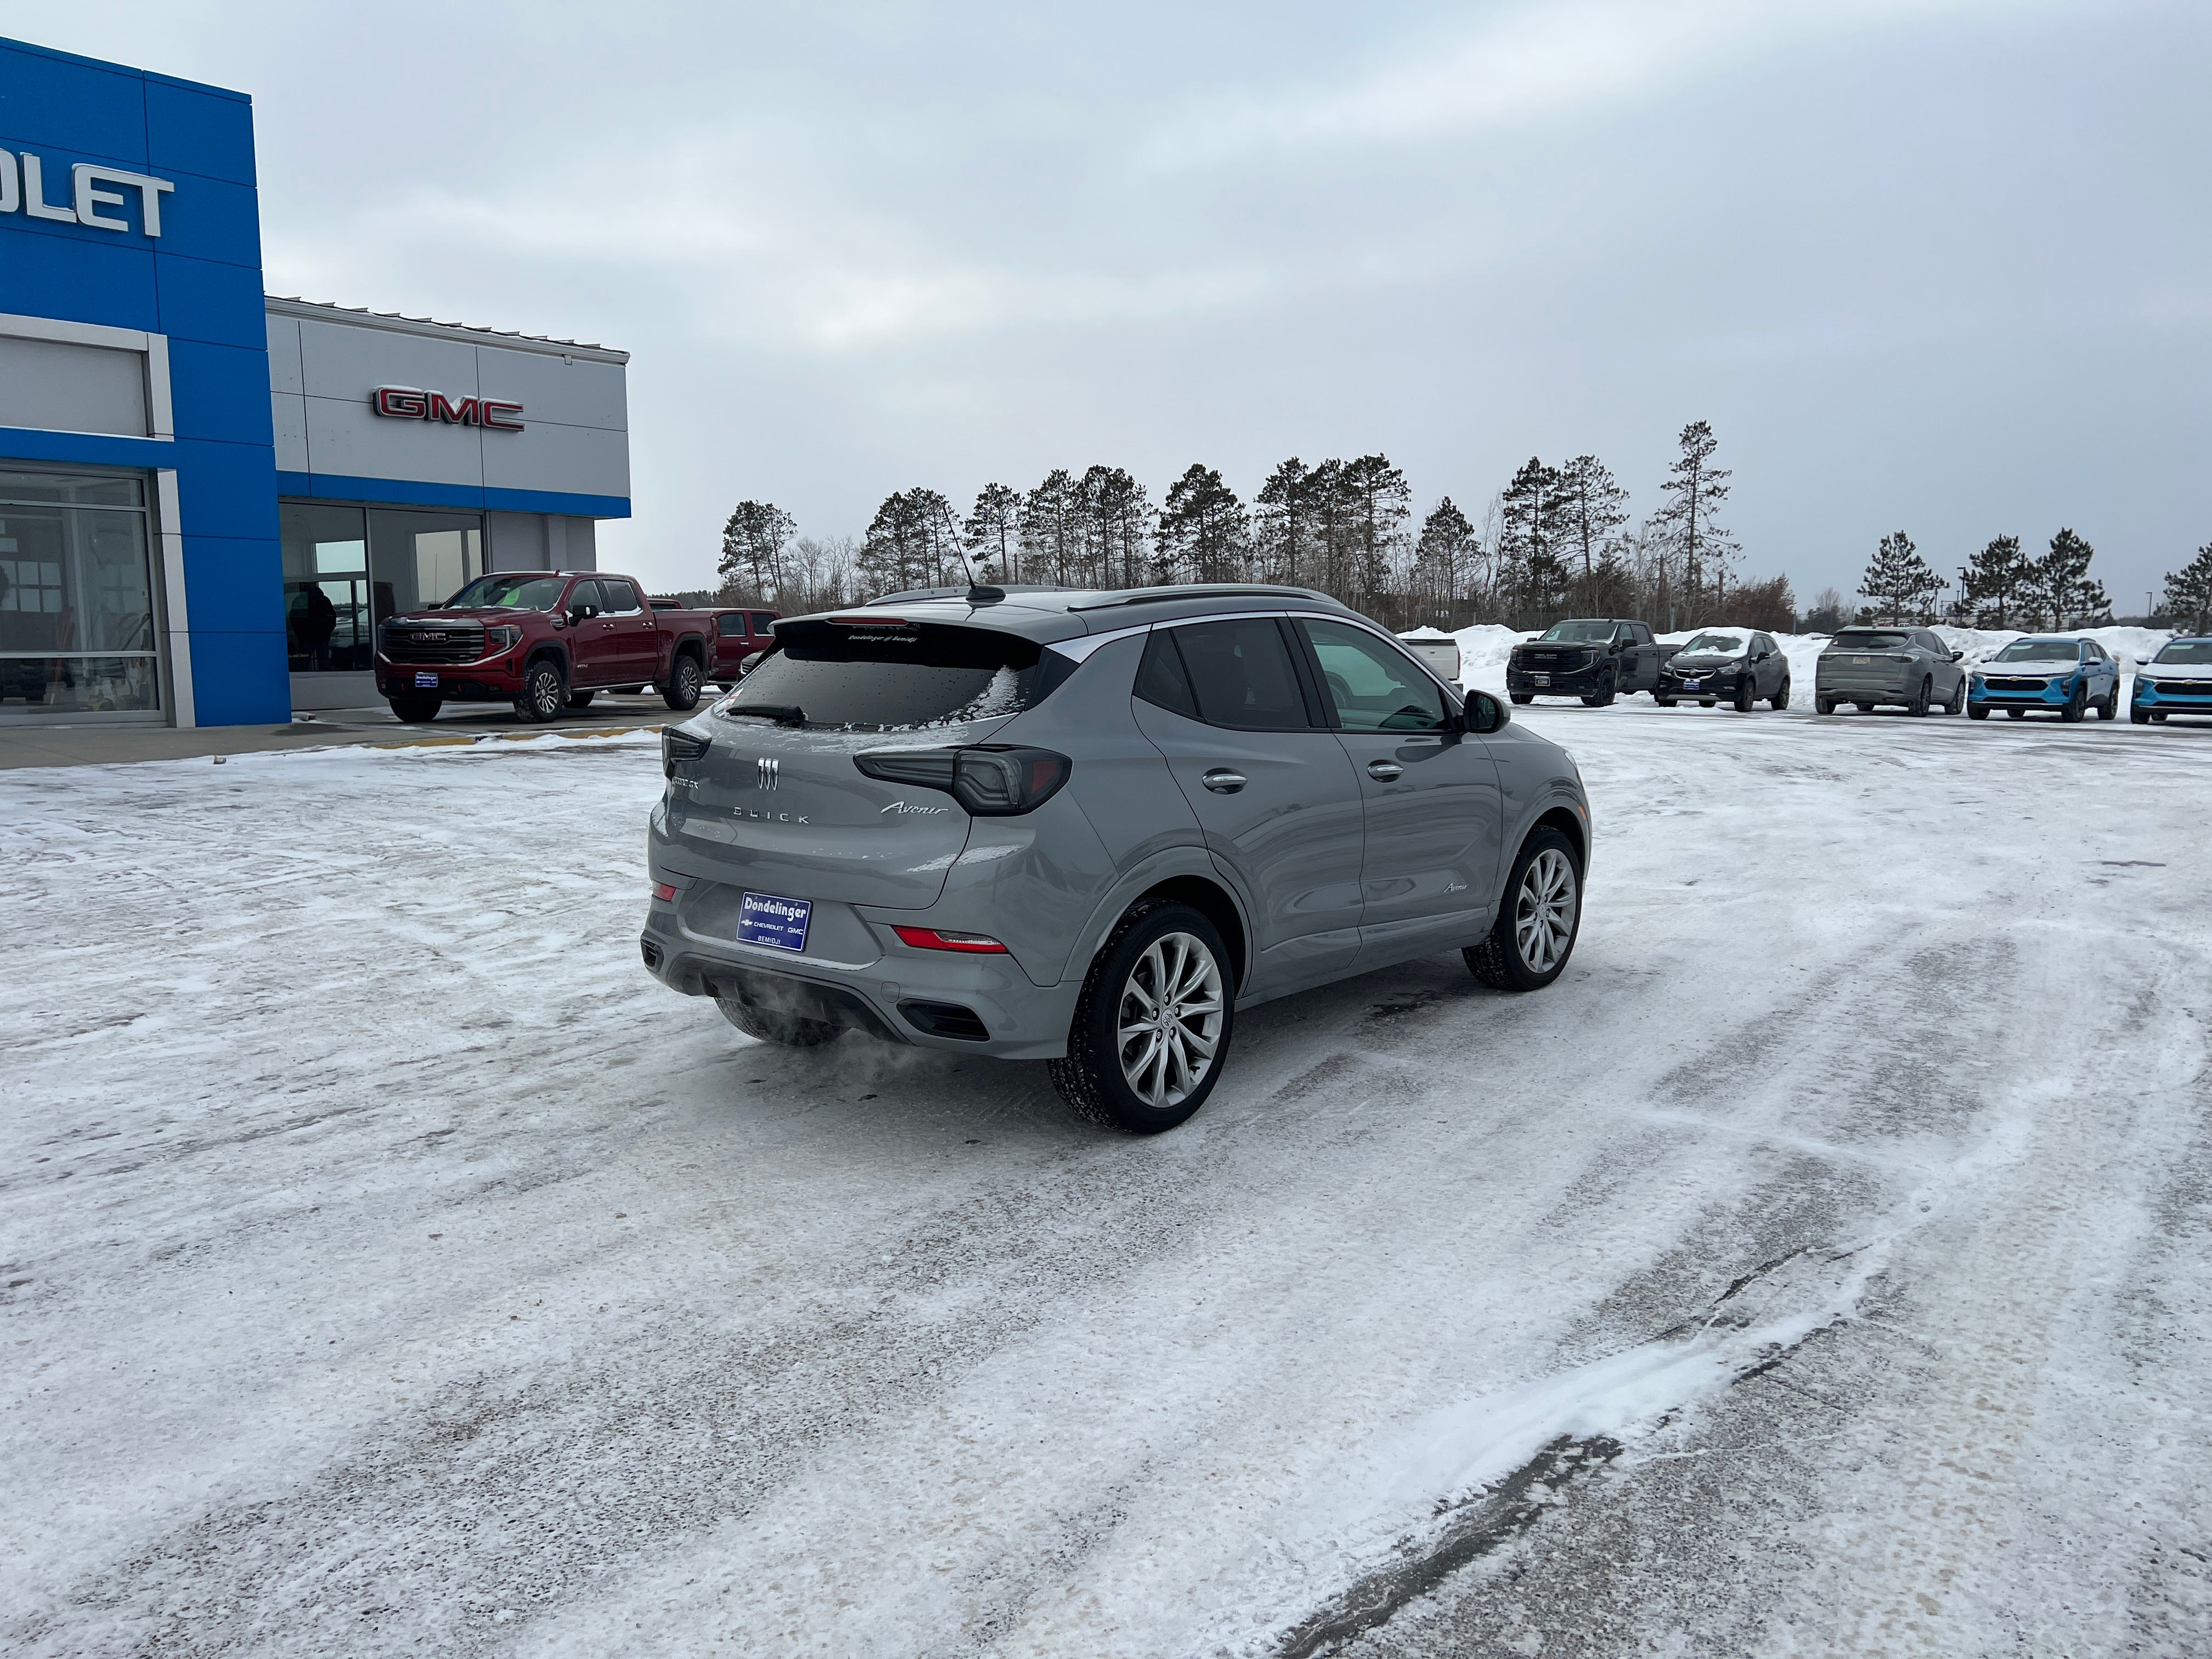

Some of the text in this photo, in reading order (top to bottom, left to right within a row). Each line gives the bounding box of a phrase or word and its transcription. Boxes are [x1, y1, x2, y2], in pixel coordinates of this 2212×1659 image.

[372, 385, 524, 432] GMC
[410, 633, 446, 641] GMC
[733, 806, 810, 824] BUICK
[880, 800, 949, 815] Avenir
[744, 896, 806, 922] Dondelinger
[754, 921, 804, 935] CHEVROLET GMC
[758, 935, 781, 945] BEMIDJI
